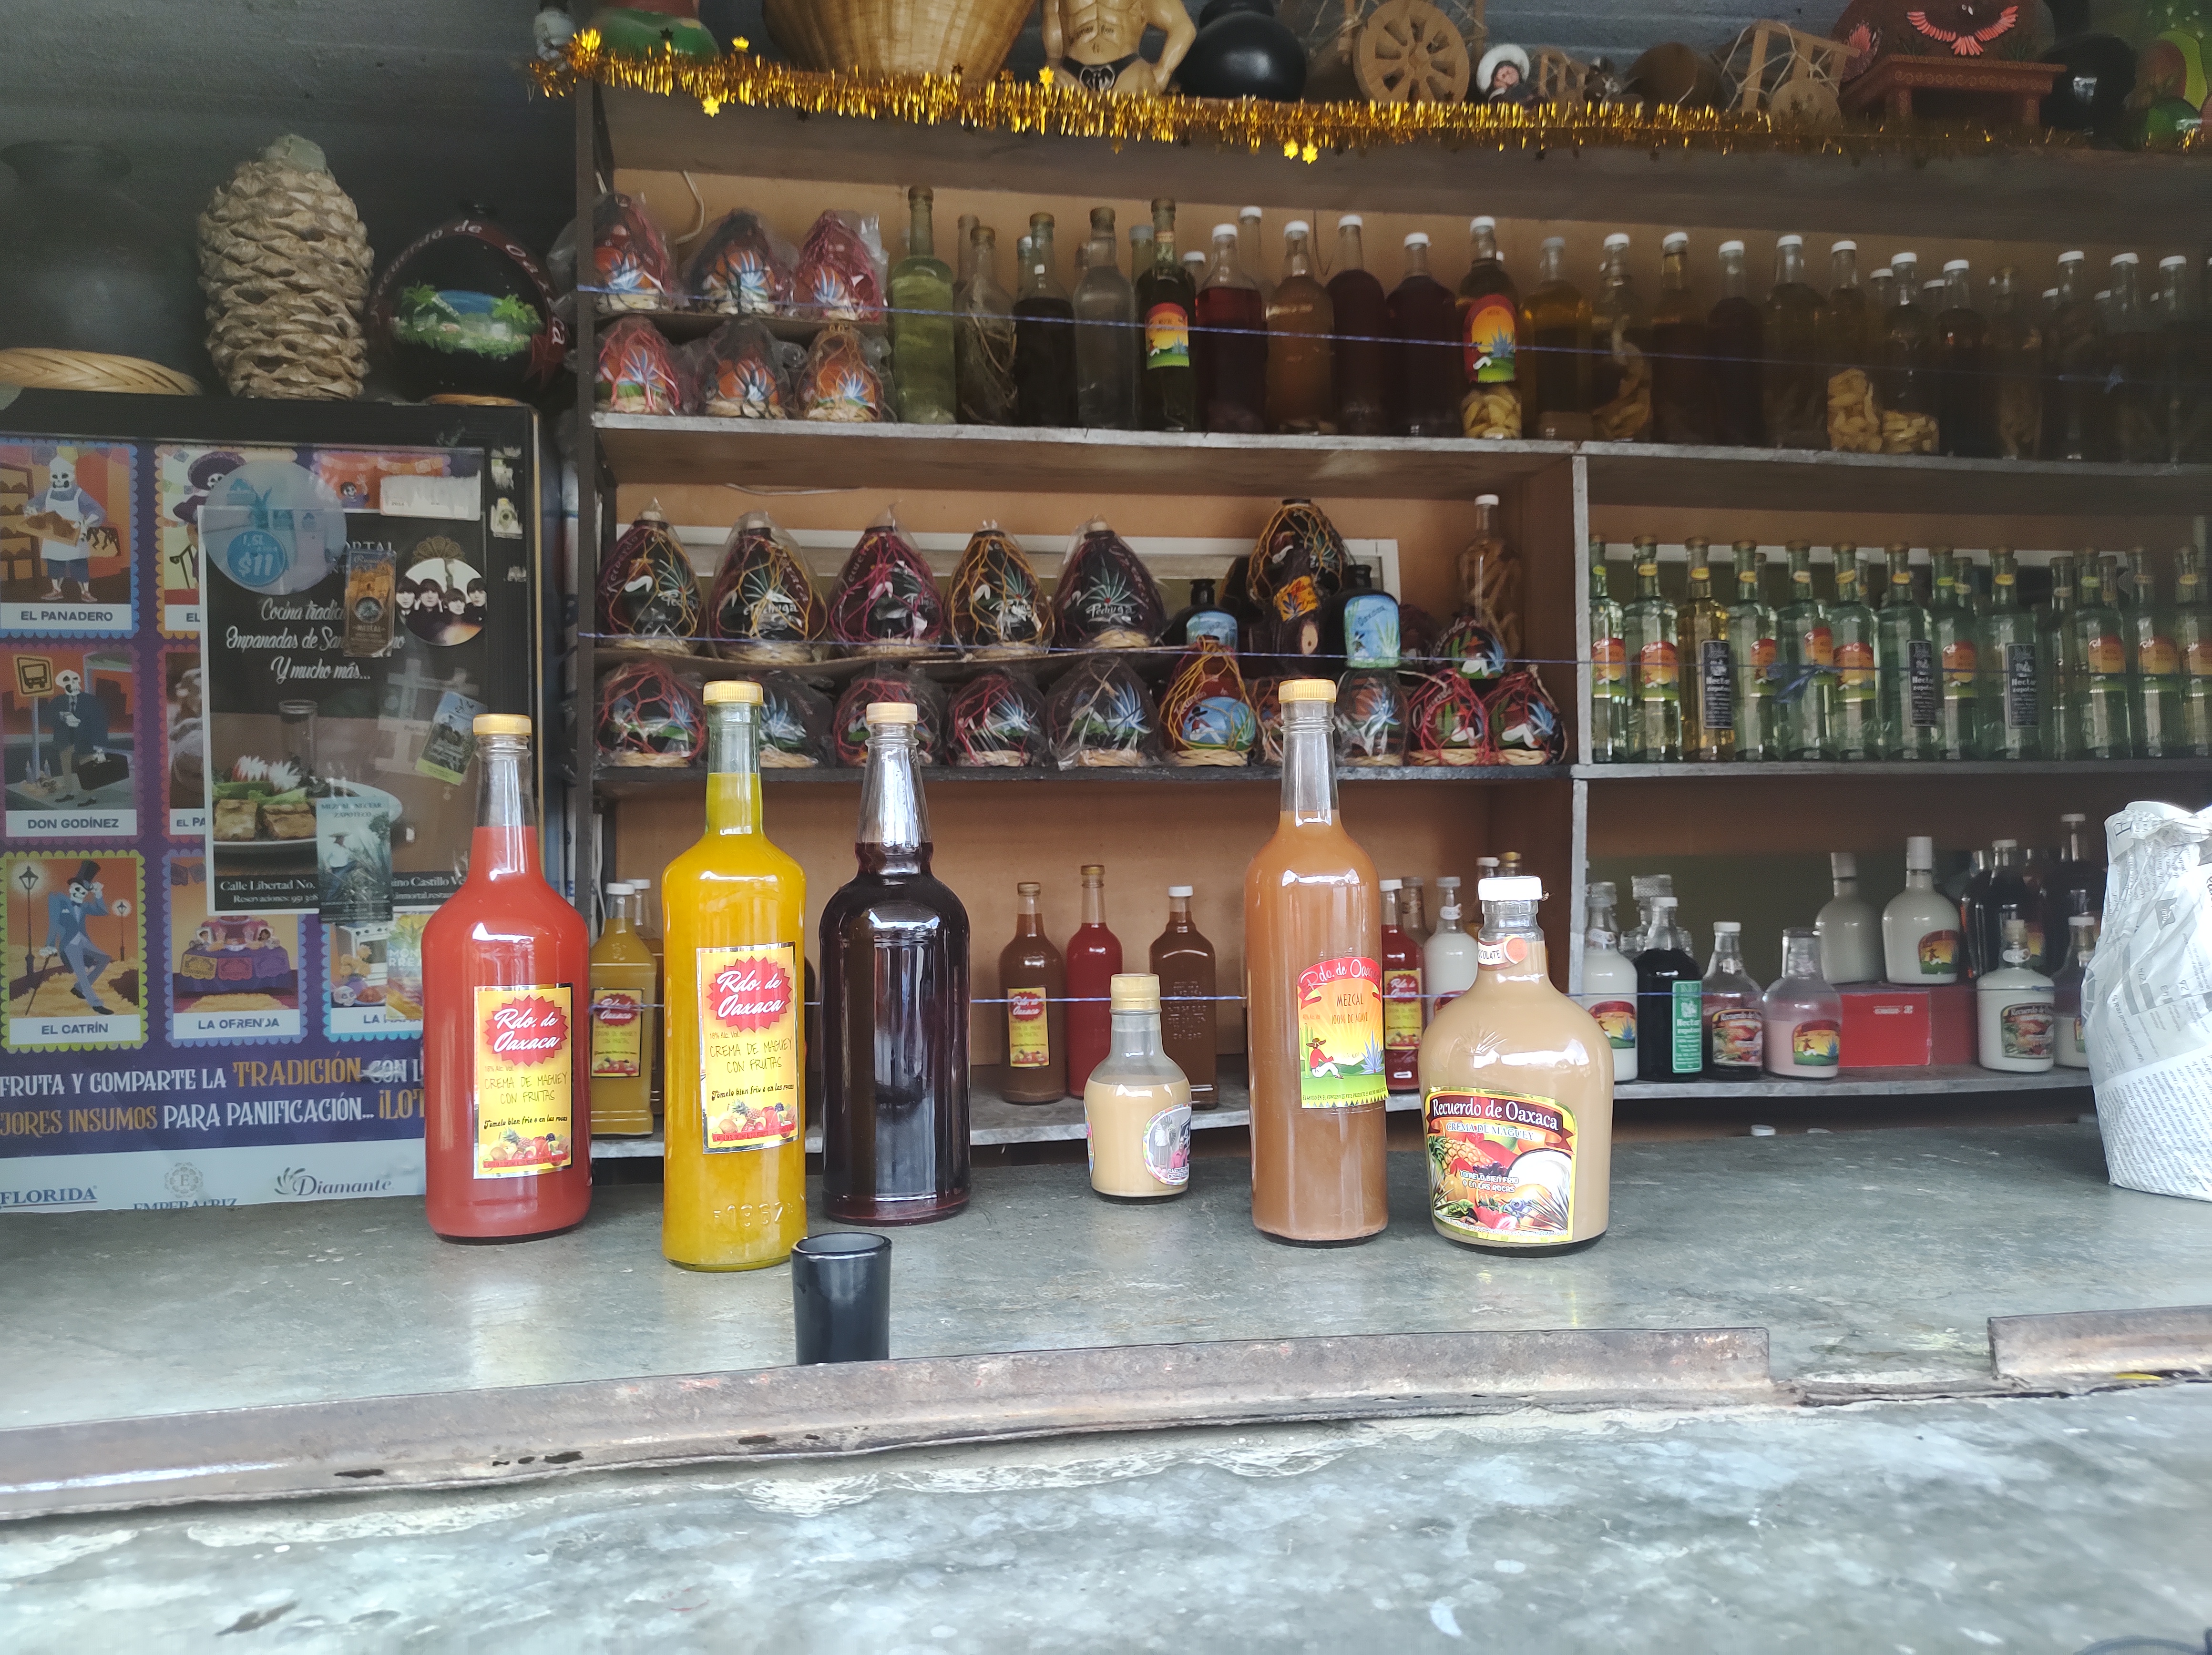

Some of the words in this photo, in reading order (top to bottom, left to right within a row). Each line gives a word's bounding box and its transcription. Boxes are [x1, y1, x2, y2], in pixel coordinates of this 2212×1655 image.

[21, 611, 38, 621] EL
[41, 610, 113, 622] PANADERO
[186, 612, 200, 623] EL
[261, 597, 303, 621] Cocina
[1086, 603, 1137, 618] Pechuga
[226, 625, 299, 653] Empanadas
[302, 627, 318, 649] de
[270, 656, 292, 684] Y
[290, 657, 331, 679] mucho
[334, 661, 371, 679] más...
[27, 818, 57, 829] DON
[61, 816, 119, 829] GODÍNEZ
[176, 819, 189, 827] EL
[220, 880, 247, 892] Calle
[250, 879, 294, 891] Libertad
[233, 893, 289, 904] Reservaciones
[717, 970, 762, 993] Rdo.
[765, 973, 782, 990] de
[1300, 964, 1334, 990] Rdo.
[1336, 962, 1347, 976] de
[717, 994, 785, 1018] Oaxaca
[1337, 992, 1364, 1007] MEZCAL
[2112, 1001, 2122, 1014] real
[198, 1019, 215, 1030] LA
[219, 1018, 280, 1029] OFRENDA
[364, 1014, 380, 1024] LA
[494, 1008, 537, 1030] Rdo.
[541, 1011, 558, 1027] de
[1331, 1014, 1346, 1024] 100%
[1348, 1013, 1354, 1023] DE
[1355, 1012, 1368, 1023] AGAVE
[2117, 1014, 2130, 1033] anual
[41, 1025, 58, 1035] EL
[61, 1021, 109, 1034] CATRÍN
[494, 1030, 560, 1053] Oaxaca
[709, 1042, 741, 1058] CREMA
[746, 1042, 759, 1056] DE
[763, 1036, 794, 1054] MAGUEY
[2125, 1032, 2145, 1063] Variación
[72, 1073, 84, 1094] Y
[90, 1068, 196, 1093] COMPARTE
[202, 1067, 227, 1090] LA
[233, 1051, 362, 1088] TRADICIÓN
[368, 1059, 407, 1083] CON
[727, 1060, 745, 1073] CON
[750, 1056, 782, 1071] FRUTAS
[484, 1077, 515, 1089] CREMA
[520, 1076, 533, 1088] DE
[537, 1072, 568, 1087] MAGUEY
[2144, 1074, 2153, 1087] una
[2158, 1069, 2181, 1105] incrementos
[500, 1092, 518, 1104] CON
[522, 1089, 555, 1103] FRUTAS
[736, 1087, 749, 1096] bien
[2149, 1086, 2166, 1112] trazando
[2140, 1084, 2161, 1117] importante
[0, 1110, 63, 1138] JORES
[69, 1105, 158, 1133] INSUMOS
[164, 1103, 221, 1131] PARA
[226, 1092, 374, 1126] PANIFICACIÓN...
[1432, 1097, 1482, 1117] Recuerdo
[1485, 1099, 1503, 1118] de
[1505, 1101, 1559, 1131] Oaxaca
[1446, 1122, 1475, 1132] CREMA
[1477, 1124, 1490, 1134] DE
[1490, 1125, 1534, 1141] MAGUEY
[293, 1175, 392, 1196] Diamante
[1459, 1169, 1485, 1181] TOMELO
[1502, 1175, 1519, 1185] FRIO
[0, 1187, 97, 1205] FLORIDA
[1478, 1182, 1491, 1191] LAS
[1492, 1183, 1516, 1193] ROCAS
